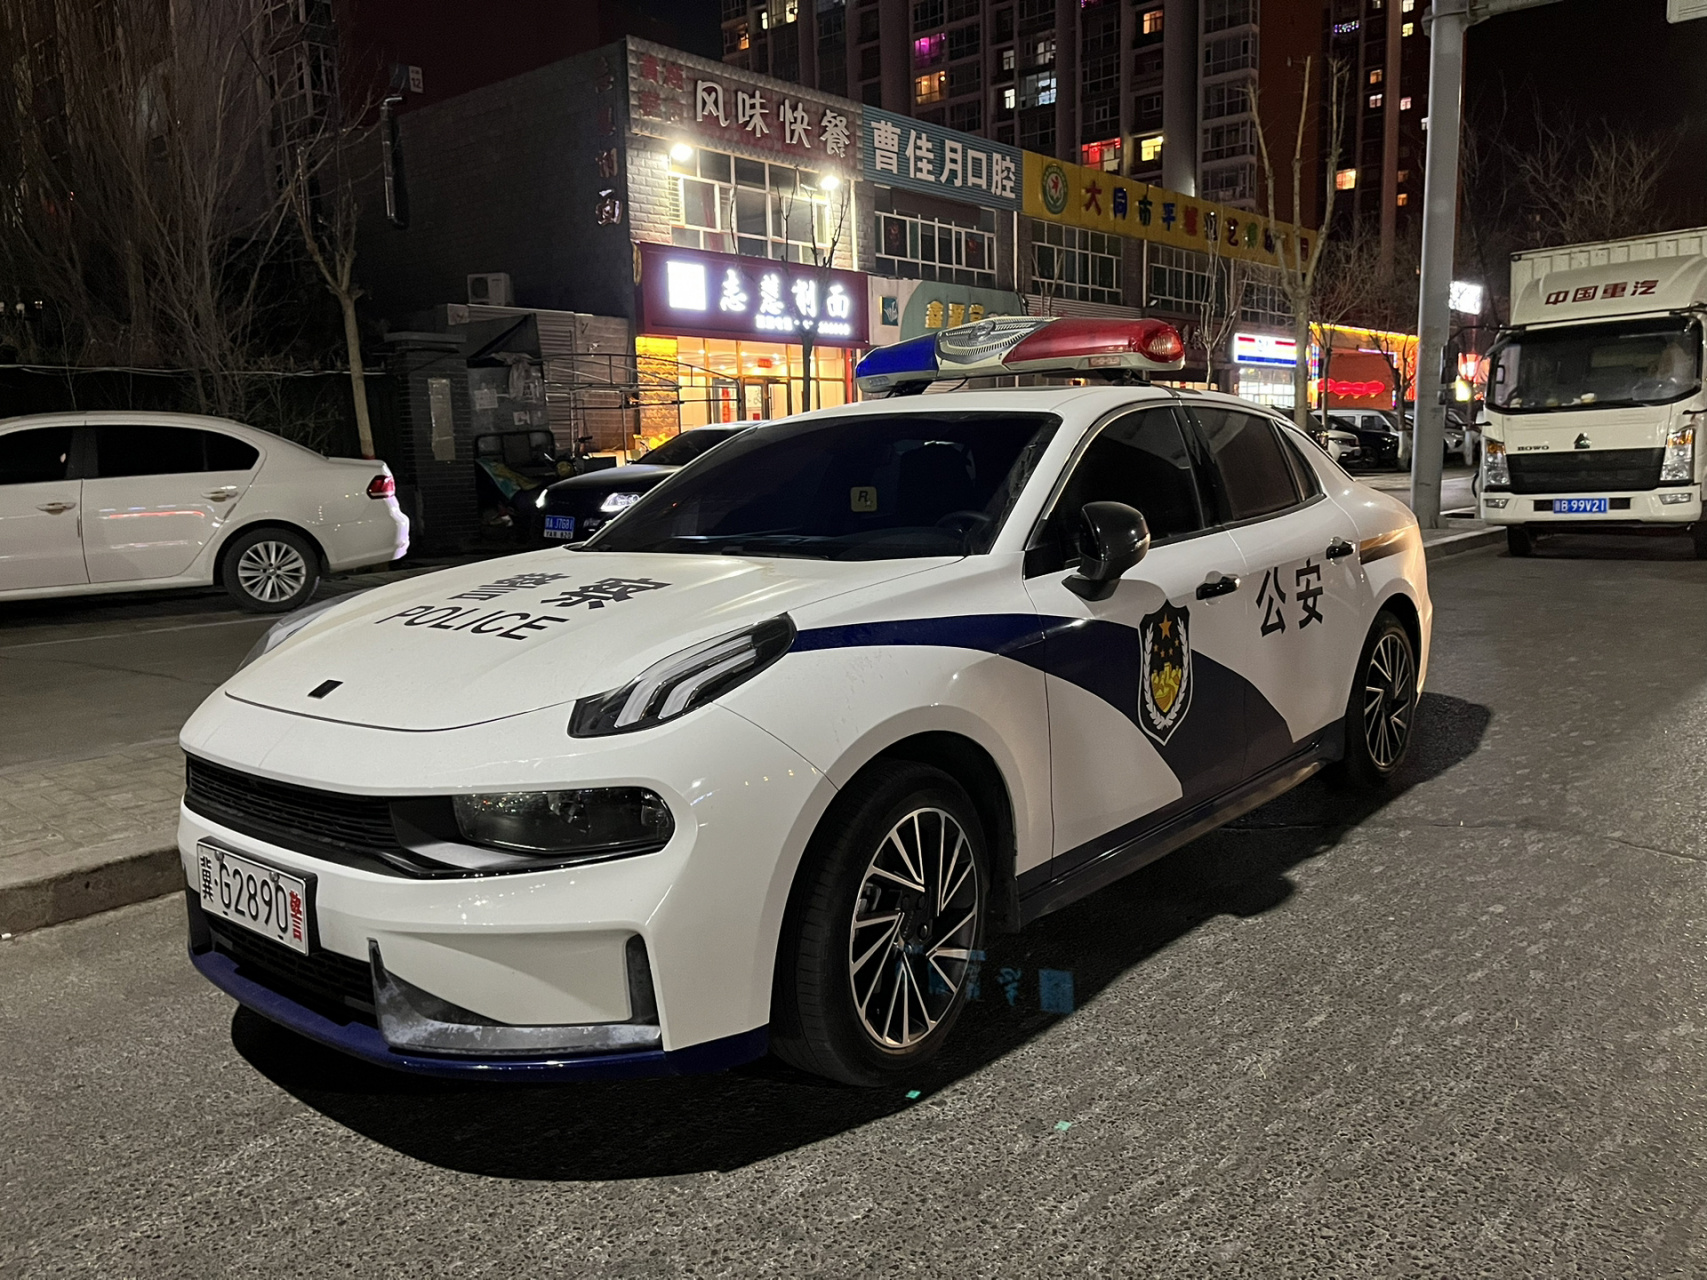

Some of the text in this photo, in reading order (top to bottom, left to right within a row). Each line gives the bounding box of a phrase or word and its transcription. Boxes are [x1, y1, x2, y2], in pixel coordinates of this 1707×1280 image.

[695, 80, 850, 158] 风味快餐
[871, 120, 1016, 199] 曹佳月口腔
[1545, 279, 1660, 306] 中国重汽
[448, 572, 672, 609] 警察
[1255, 557, 1323, 637] 公安
[374, 605, 569, 640] POLICE
